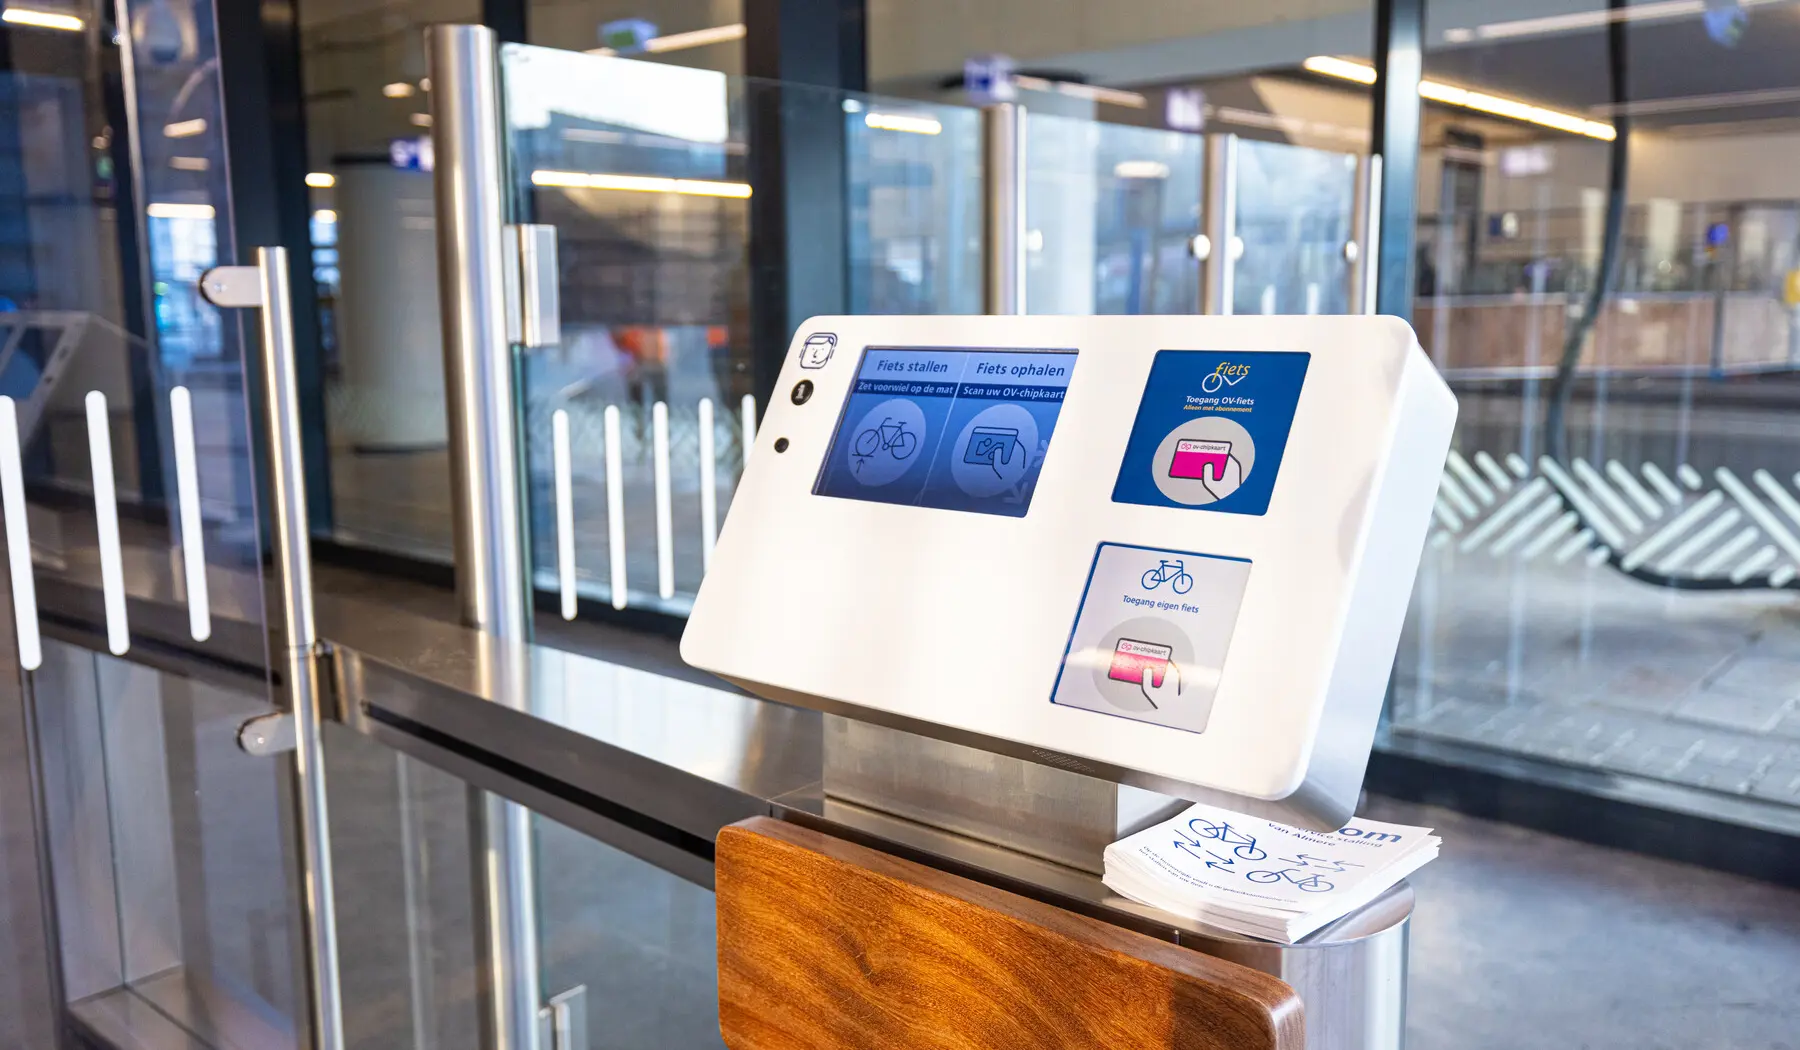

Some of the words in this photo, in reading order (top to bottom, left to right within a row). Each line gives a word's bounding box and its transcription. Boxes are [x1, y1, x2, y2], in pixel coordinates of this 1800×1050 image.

[876, 360, 905, 371] Fiets
[907, 361, 948, 373] stallen
[976, 362, 1007, 374] Fiets
[1010, 363, 1065, 378] ophalen
[1211, 361, 1251, 383] fiets
[858, 382, 871, 390] Zet
[873, 383, 910, 392] voorwiel
[910, 385, 922, 394] op
[923, 384, 934, 393] de
[936, 386, 954, 394] mat
[963, 386, 984, 395] Scan
[986, 388, 1001, 396] uw
[1003, 387, 1065, 400] OV-chipkaart
[1186, 395, 1219, 405] Toegang
[1221, 396, 1255, 405] OV-fiets
[1215, 405, 1252, 413] abonnement
[1123, 595, 1155, 608] Toegang
[1157, 601, 1179, 610] eigen
[1181, 603, 1199, 614] fiets
[1292, 832, 1336, 847] Almere
[1337, 837, 1383, 848] stalling
